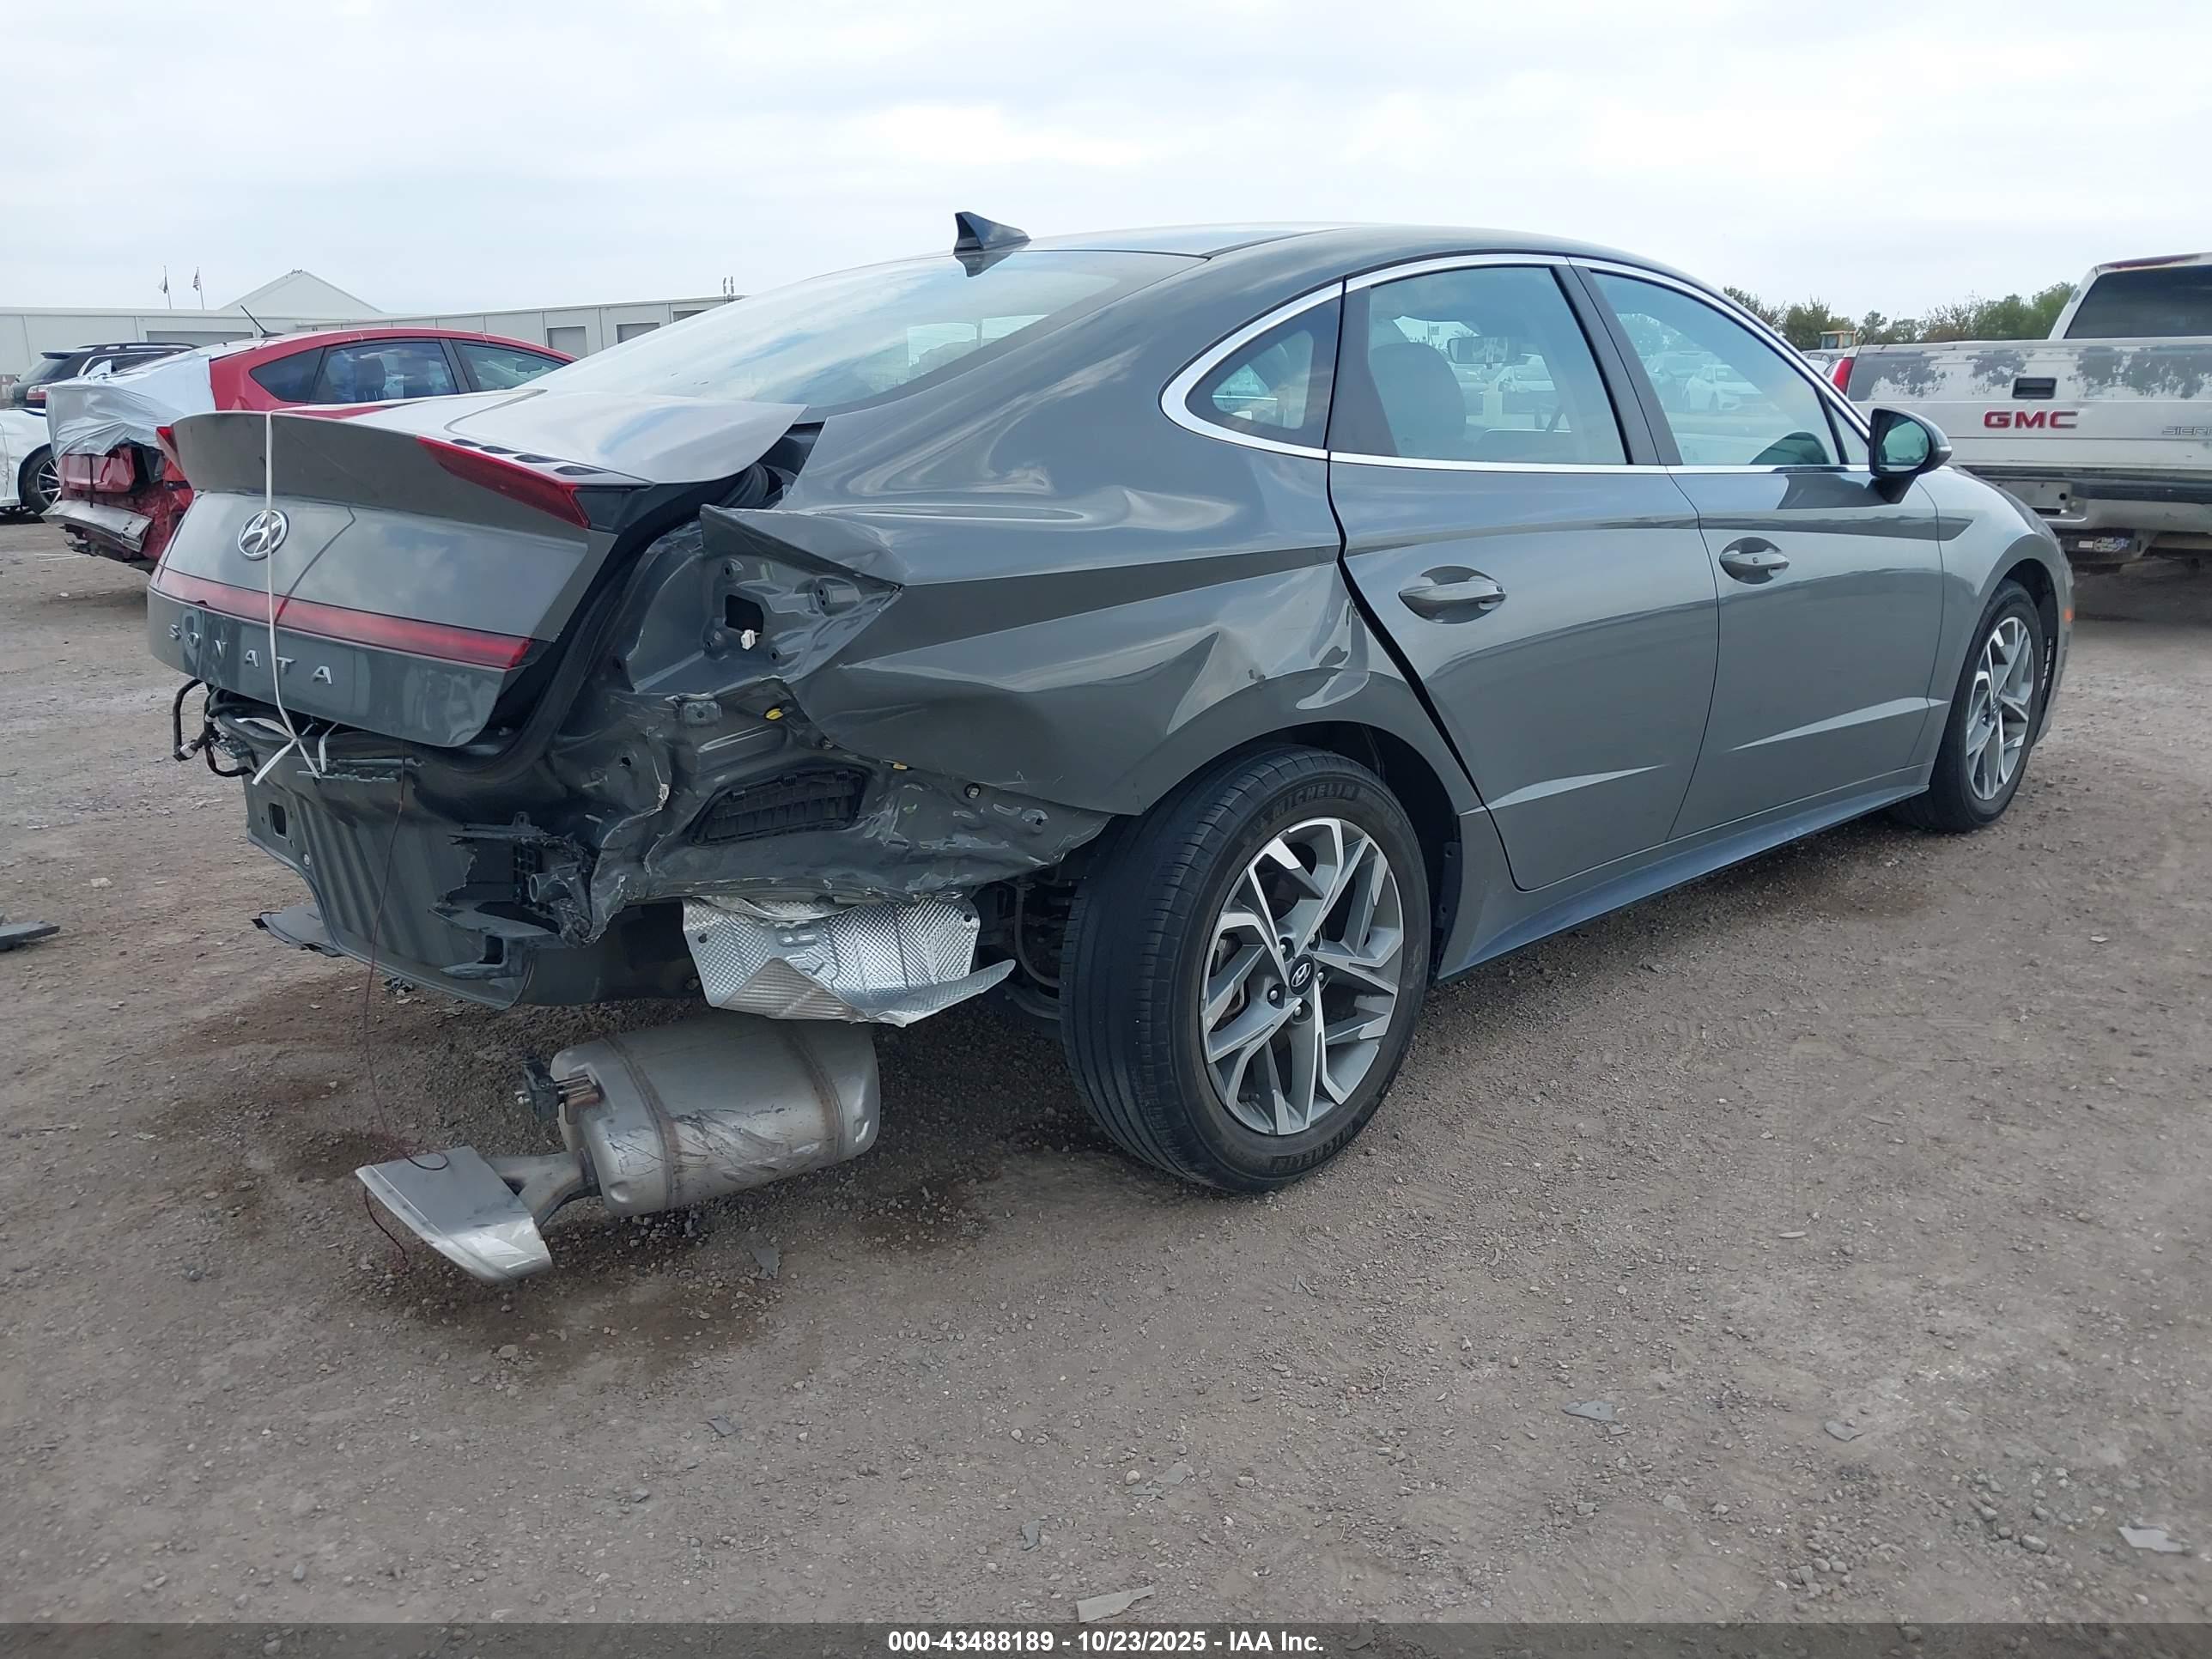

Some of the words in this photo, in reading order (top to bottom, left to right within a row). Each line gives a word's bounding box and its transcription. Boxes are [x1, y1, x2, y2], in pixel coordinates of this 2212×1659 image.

[1984, 410, 2079, 429] GMC
[168, 623, 333, 684] SONATA
[1273, 782, 1356, 818] MICHELIN
